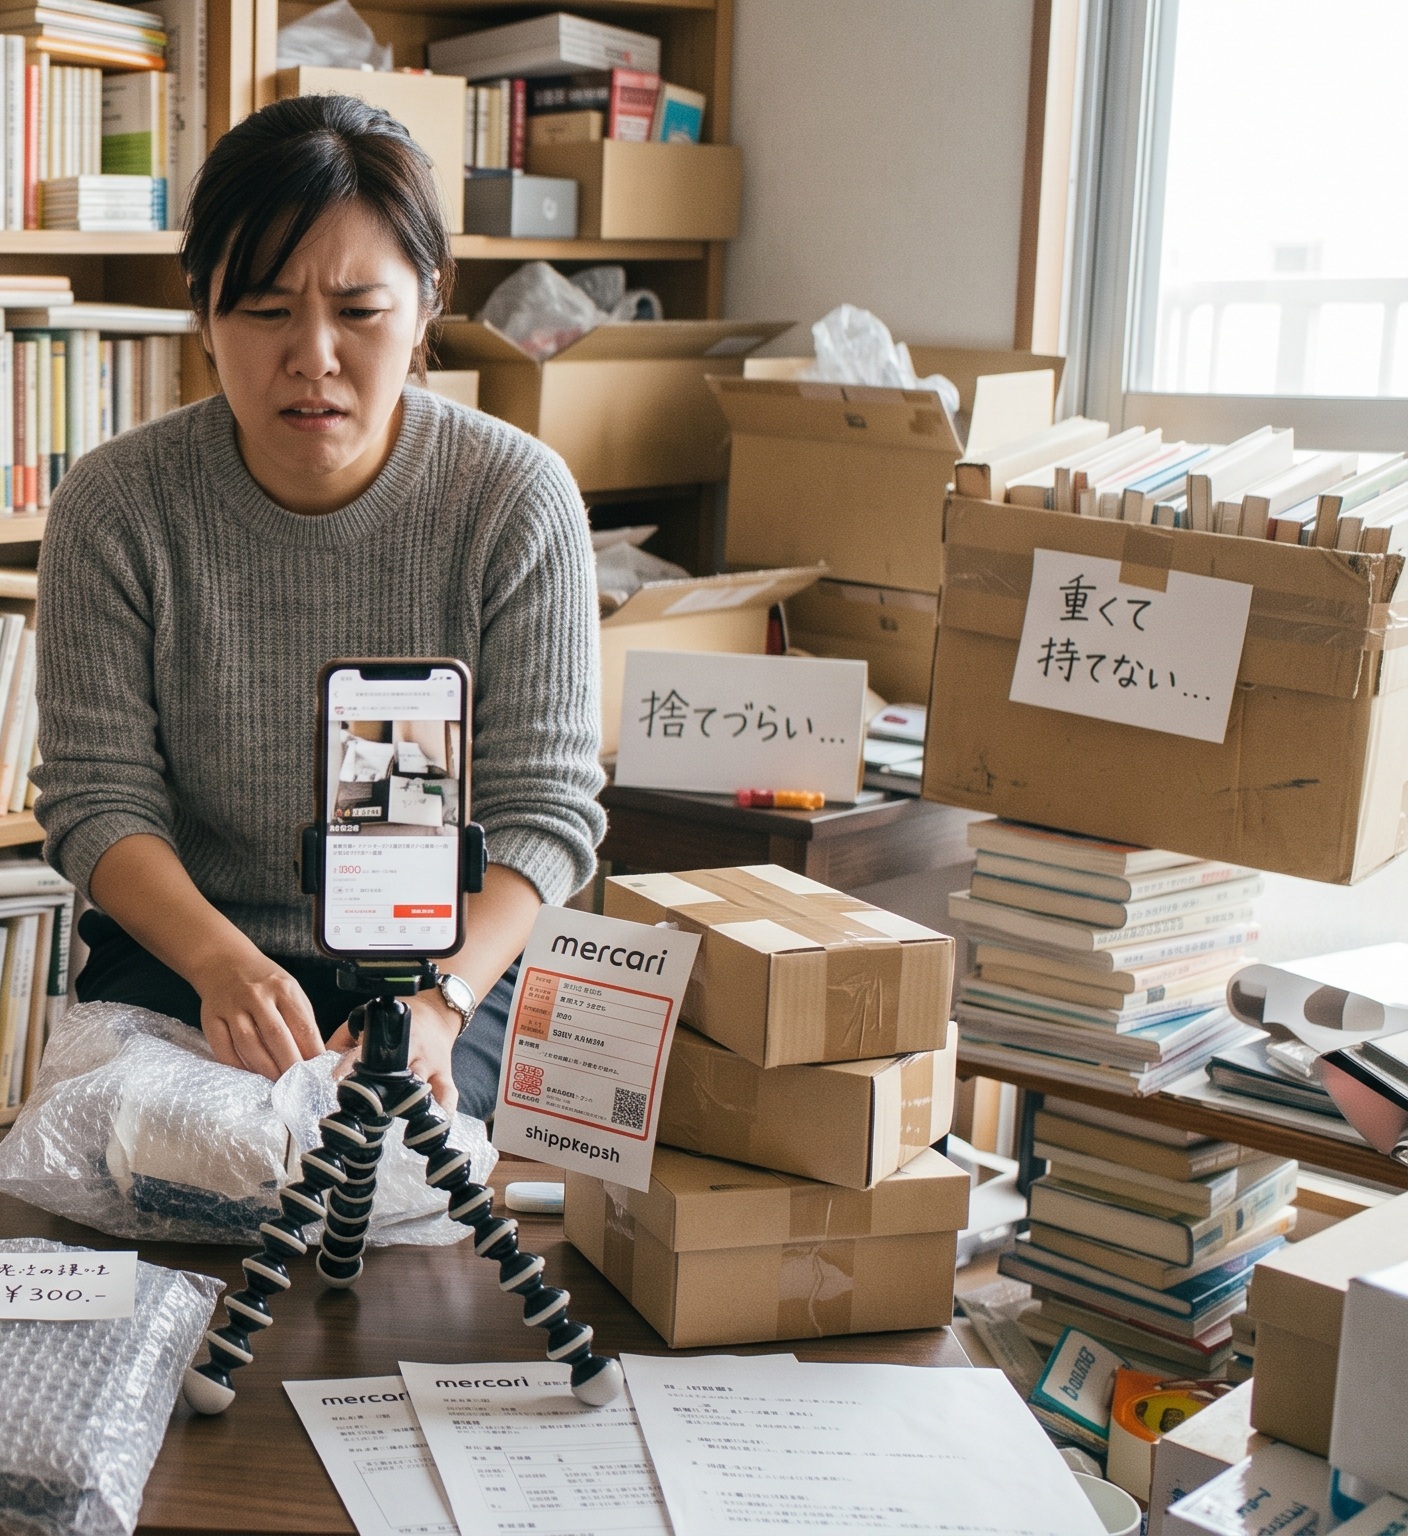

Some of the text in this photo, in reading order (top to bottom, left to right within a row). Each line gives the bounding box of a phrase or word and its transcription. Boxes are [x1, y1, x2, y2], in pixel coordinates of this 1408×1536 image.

[1058, 573, 1152, 631] 重くて
[550, 935, 668, 976] mercari
[524, 1125, 620, 1164] shippkepsh
[435, 1375, 530, 1388] mercari
